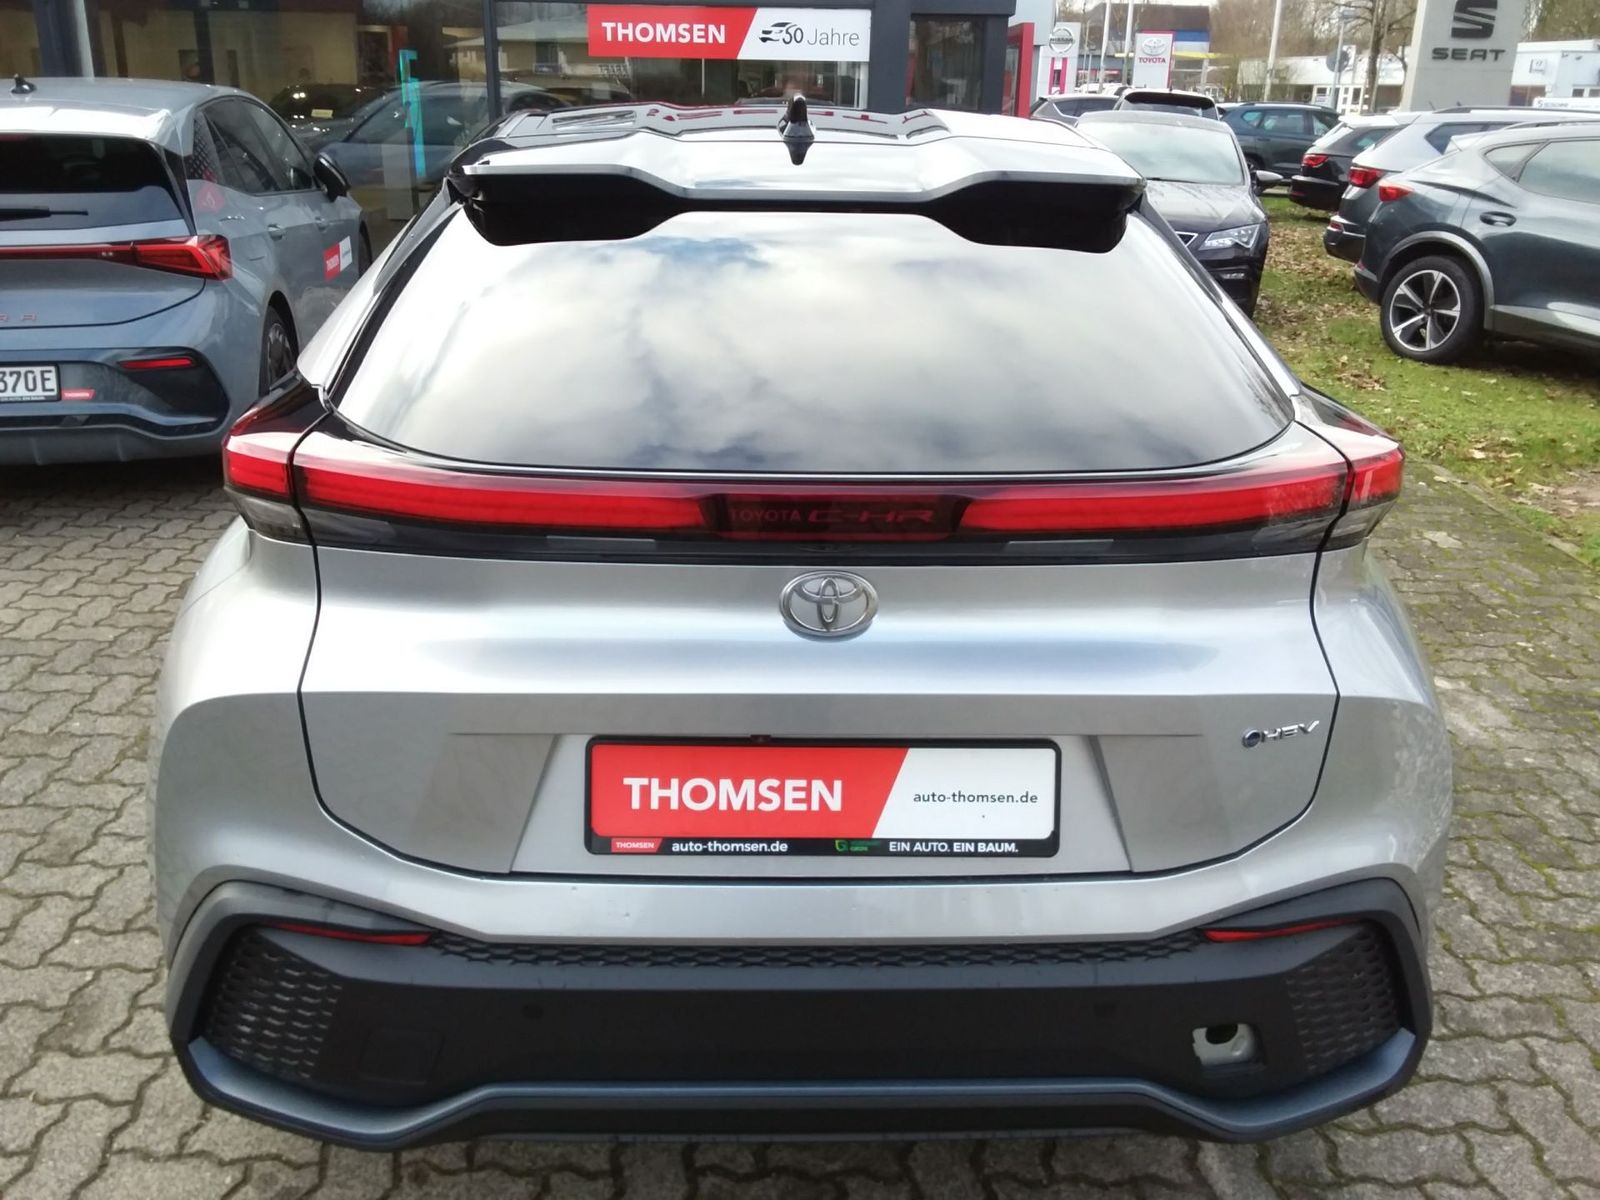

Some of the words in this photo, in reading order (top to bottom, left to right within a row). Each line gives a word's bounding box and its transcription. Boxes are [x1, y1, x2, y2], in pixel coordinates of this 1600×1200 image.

[601, 22, 726, 43] THOMSEN
[807, 27, 859, 47] Jahre
[1431, 47, 1506, 62] SEAT
[731, 509, 800, 522] TOYOTA
[807, 509, 935, 523] C-HR
[1261, 720, 1320, 742] HEV
[623, 777, 842, 812] THOMSEN
[913, 790, 1038, 804] auto-thomsen.de
[615, 841, 655, 849] THOMSEN
[671, 840, 788, 852] auto-thomsen.de
[889, 841, 910, 852] EIN
[913, 841, 951, 852] AUTO.
[953, 842, 975, 852] EIN
[979, 842, 1019, 853] BAUM.
